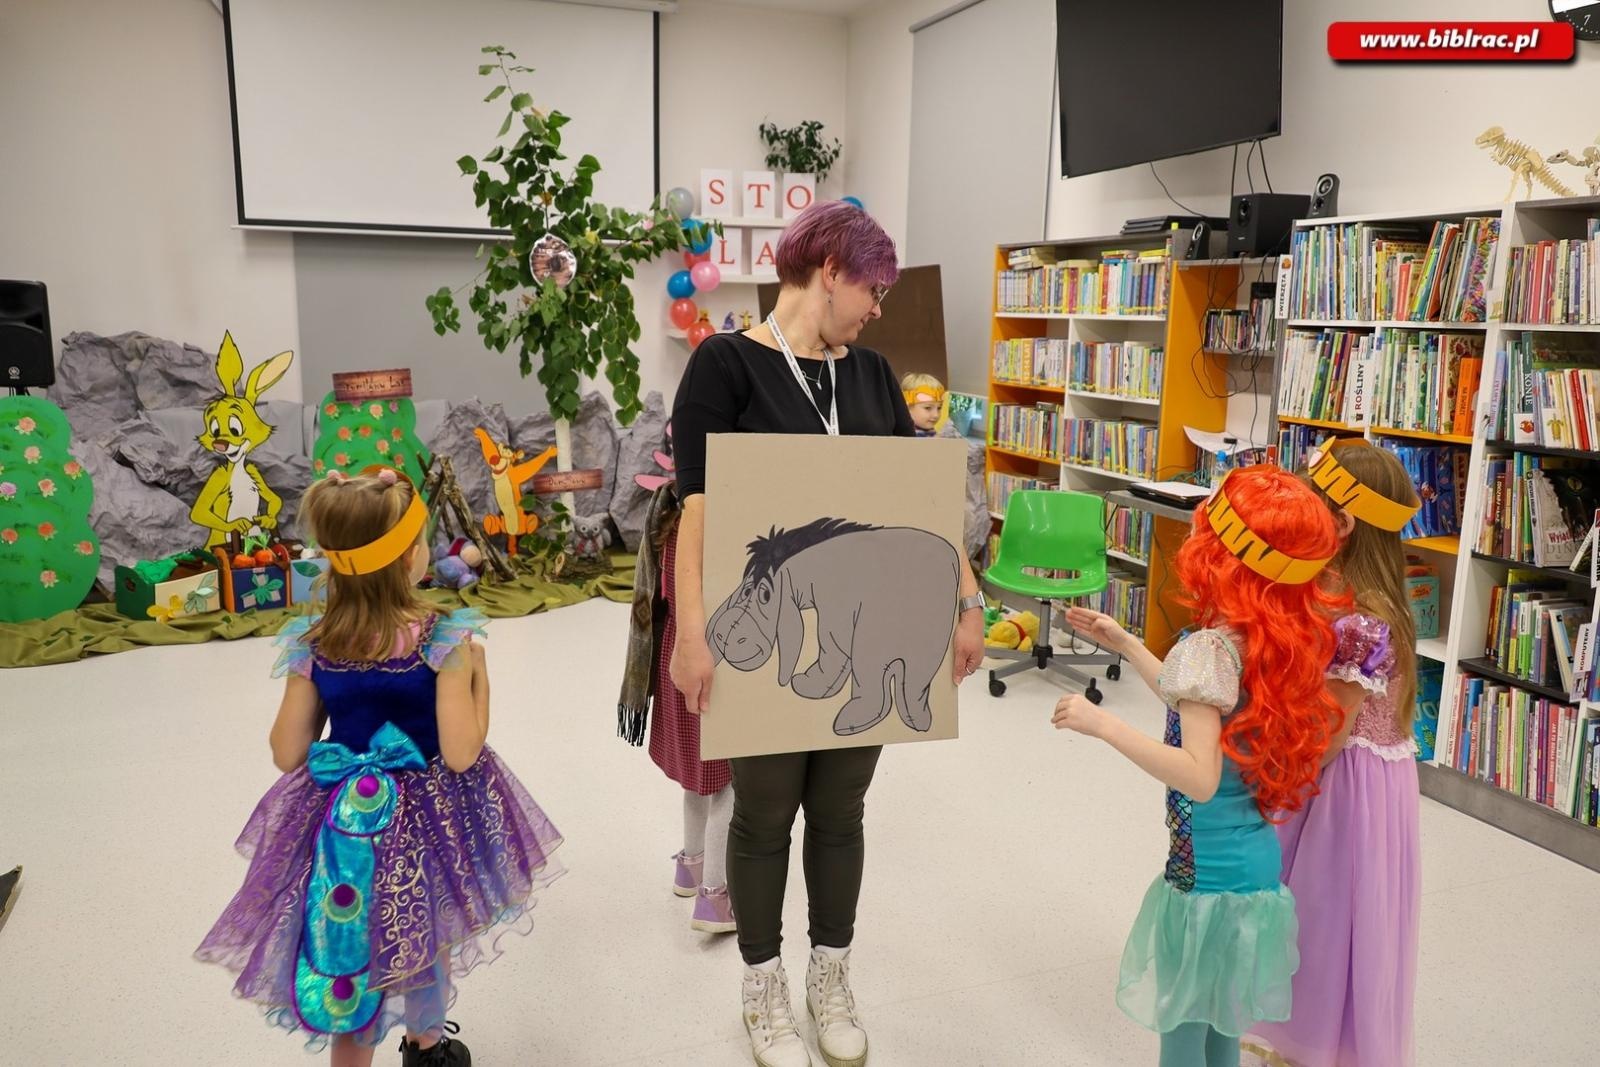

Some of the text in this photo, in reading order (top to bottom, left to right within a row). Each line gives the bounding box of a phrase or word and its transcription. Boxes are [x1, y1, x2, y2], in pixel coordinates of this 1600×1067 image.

[1584, 14, 1591, 26] 7
[1278, 273, 1287, 316] ZWIERZĘTA
[1354, 363, 1365, 410] ROŚLINY
[1524, 373, 1533, 406] KONIE
[1579, 628, 1590, 671] KOMPUTERY
